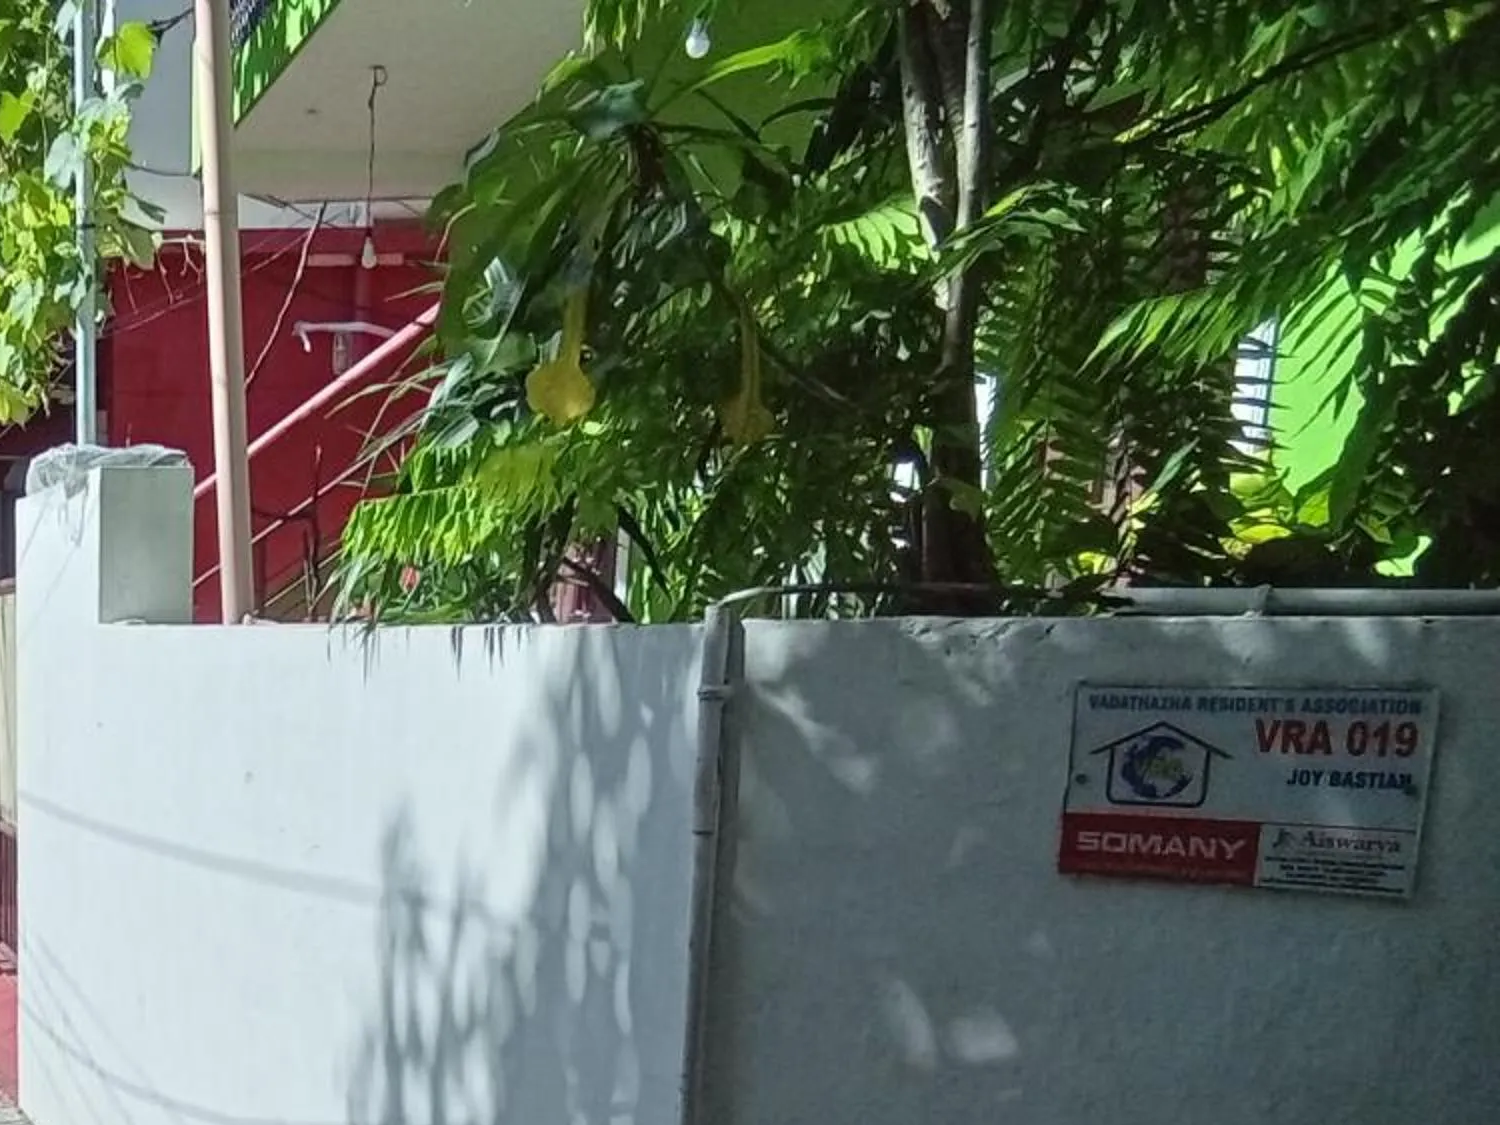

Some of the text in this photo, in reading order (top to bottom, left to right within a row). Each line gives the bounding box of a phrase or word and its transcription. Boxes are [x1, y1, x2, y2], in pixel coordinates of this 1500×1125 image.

[1300, 697, 1422, 714] ASSOCIATION
[1255, 720, 1418, 757] VRA 019
[1286, 769, 1413, 789] JOY BASTIAN
[1076, 831, 1247, 861] SOMANY
